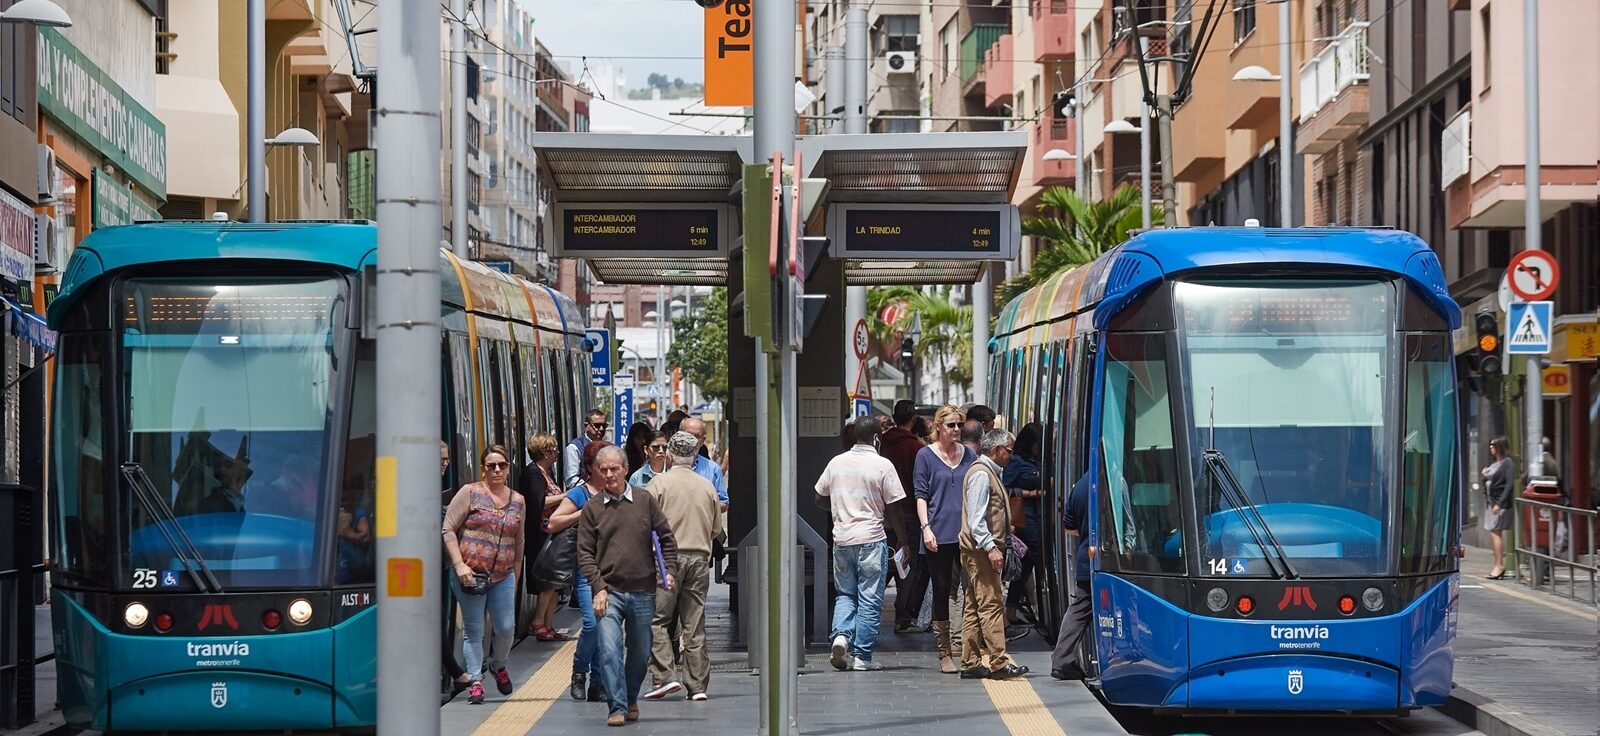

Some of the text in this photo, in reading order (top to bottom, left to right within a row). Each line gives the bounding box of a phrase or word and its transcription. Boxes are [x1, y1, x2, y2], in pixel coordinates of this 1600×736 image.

[53, 46, 60, 100] Y
[62, 53, 127, 151] COMPLEMENTOS
[128, 110, 165, 184] CANARIAS
[573, 214, 636, 223] INTERCAMBIADOR
[573, 225, 636, 234] INTERCAMBIADOR
[696, 225, 709, 234] min
[855, 226, 991, 235] LA TRINIDAD 4 min
[690, 238, 707, 246] 12:49
[972, 239, 989, 247] 12:49
[1207, 558, 1228, 575] 14
[132, 570, 157, 589] 25
[394, 563, 411, 590] T
[1270, 624, 1329, 639] tranvía
[187, 640, 250, 657] tranvía
[1279, 641, 1321, 649] metrotenerife
